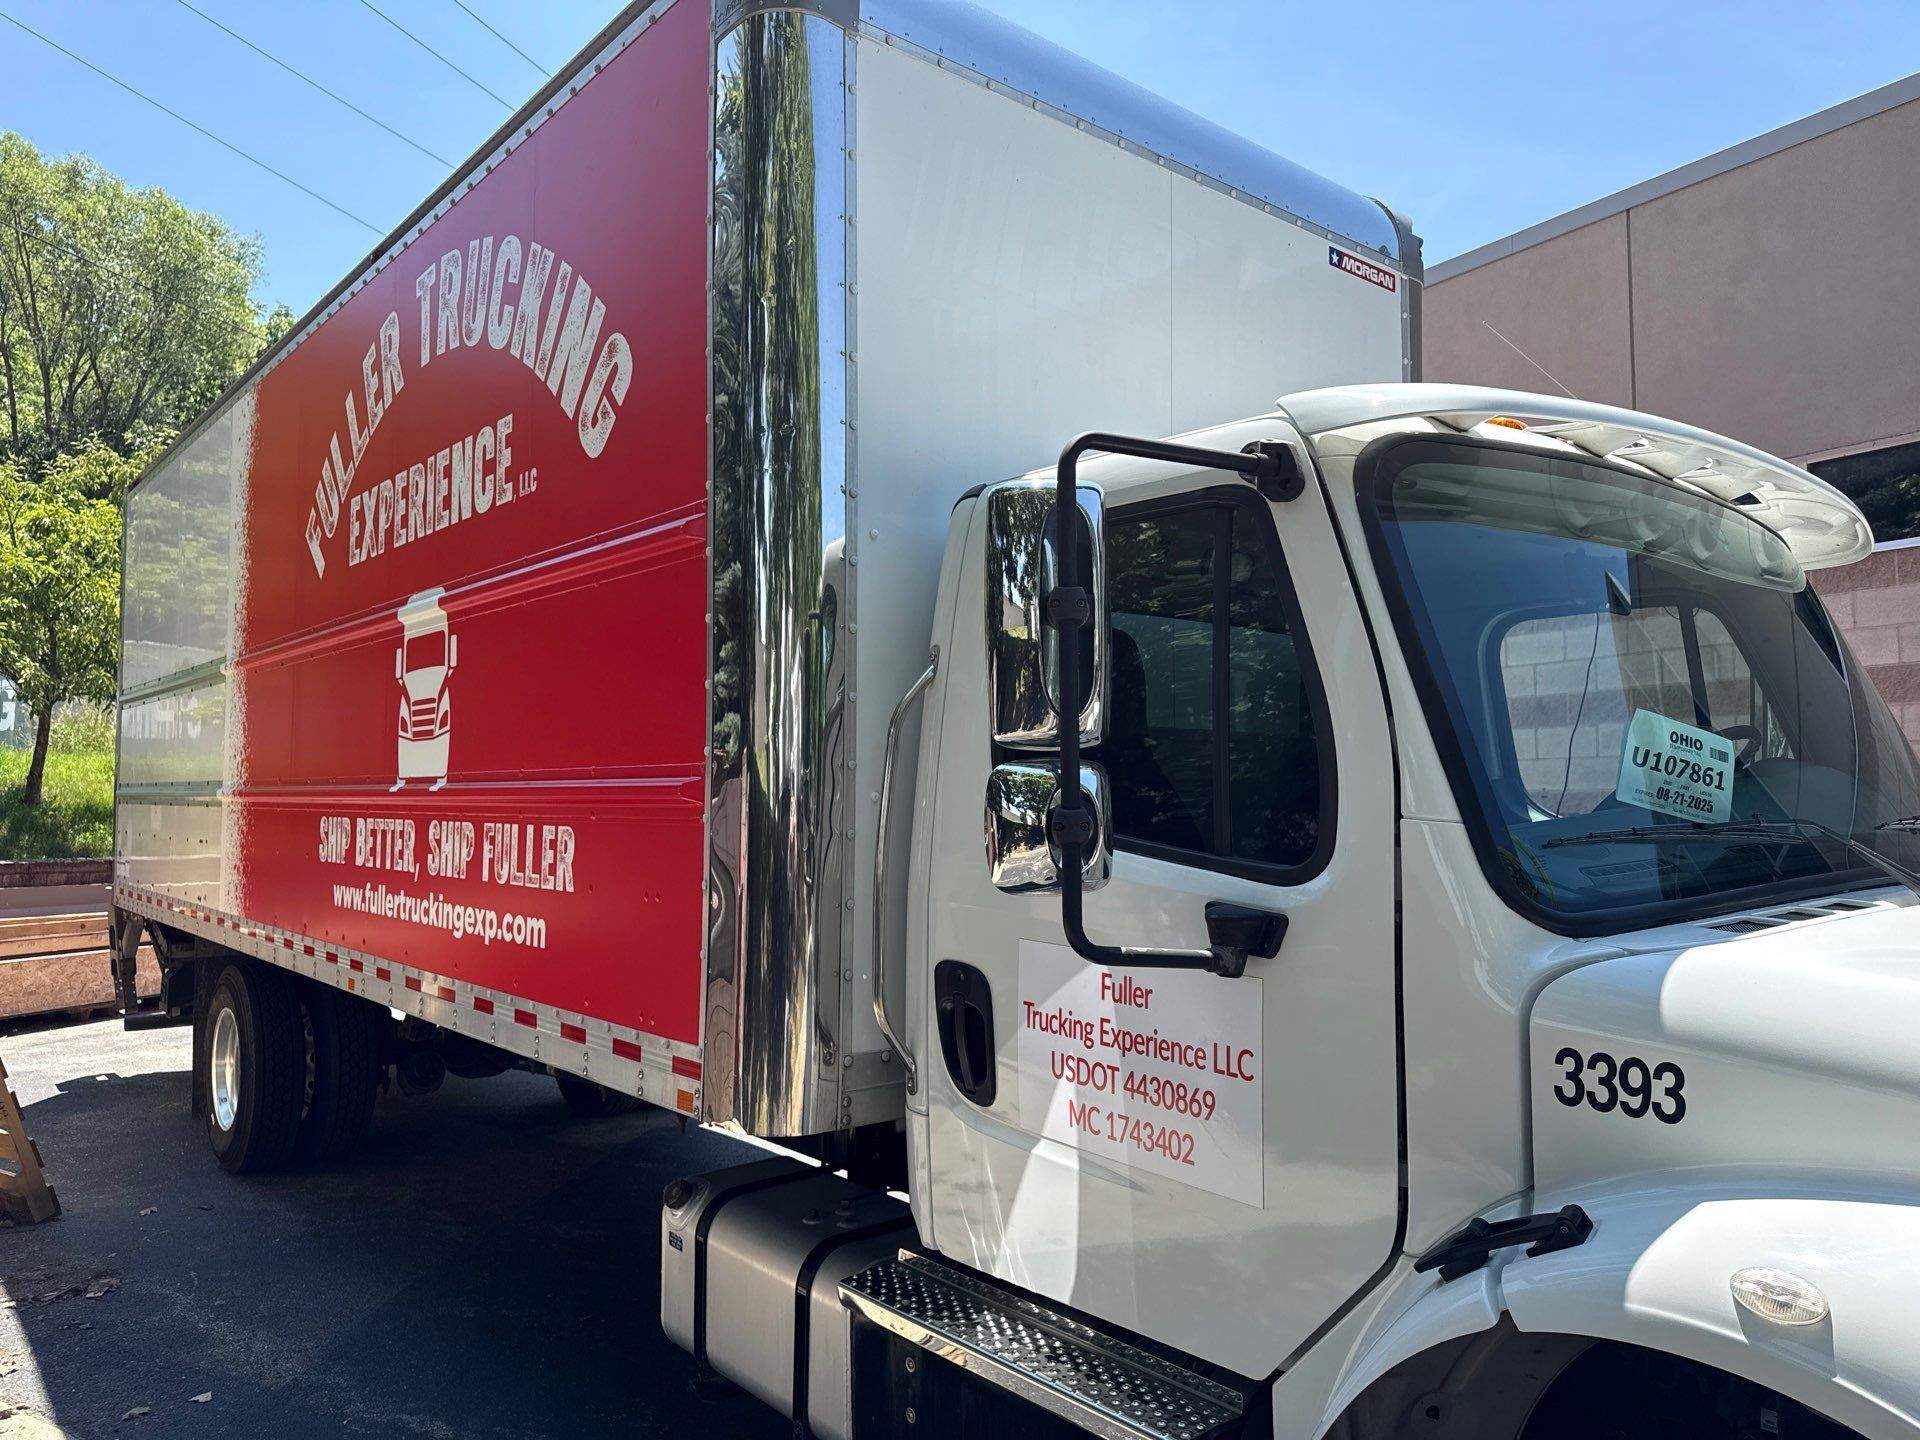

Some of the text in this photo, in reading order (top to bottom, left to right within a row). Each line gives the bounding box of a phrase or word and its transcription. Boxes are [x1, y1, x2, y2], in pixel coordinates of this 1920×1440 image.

[1341, 255, 1394, 290] MORGAN
[305, 234, 634, 580] FULLER TRUCKING
[519, 467, 538, 497] LLC
[1632, 745, 1725, 791] U107861
[1669, 730, 1704, 751] OHIO
[1656, 786, 1714, 813] 08-21-2025
[319, 816, 575, 892] SHIP BETTER, SHIP FULLER
[333, 882, 546, 949] www.fullertruckingexp.com
[1101, 972, 1153, 1009] Fuller
[1023, 1000, 1255, 1081] Trucking Experience LLC
[1051, 1050, 1216, 1121] USDOT 4430869
[1553, 1047, 1687, 1125] 3393
[1068, 1100, 1195, 1166] MC 1743402
